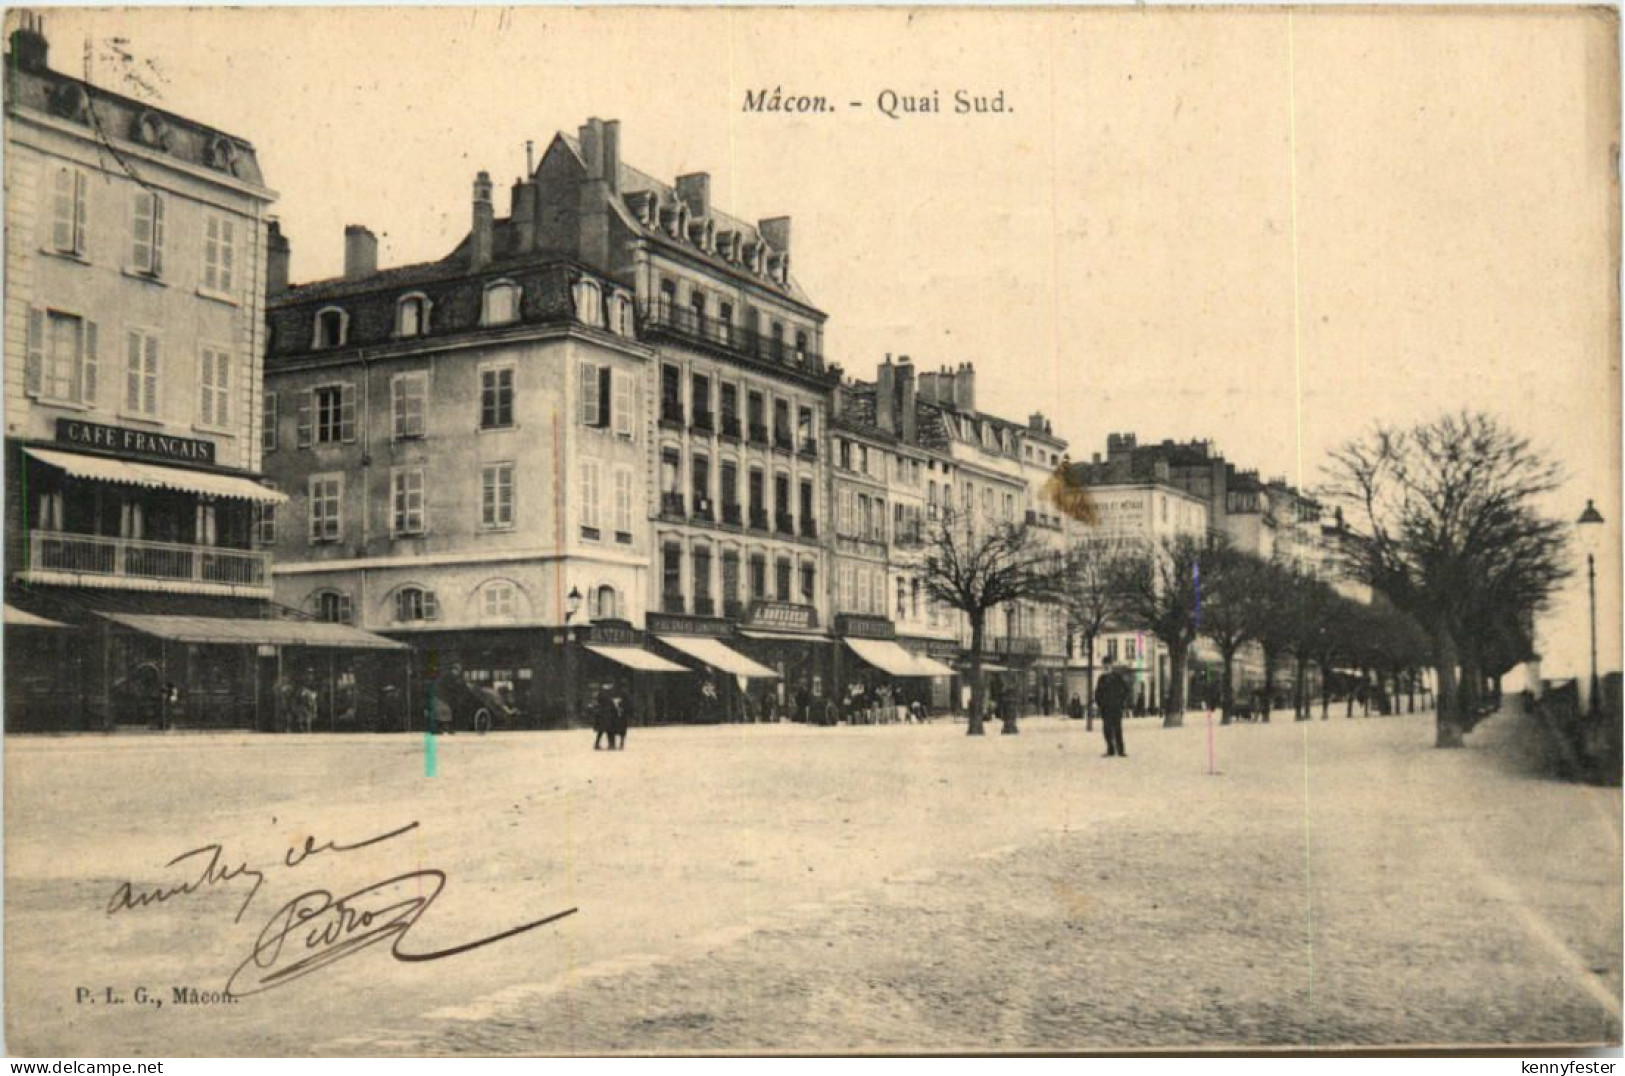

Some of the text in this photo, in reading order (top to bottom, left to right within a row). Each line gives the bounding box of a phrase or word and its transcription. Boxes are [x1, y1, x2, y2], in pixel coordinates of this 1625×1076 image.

[742, 85, 836, 113] Mâcon.
[877, 89, 940, 119] Quai
[954, 90, 1014, 113] Sud.
[75, 986, 95, 1004] P.
[105, 986, 125, 1004] L.
[171, 985, 240, 1005] Mâcon.
